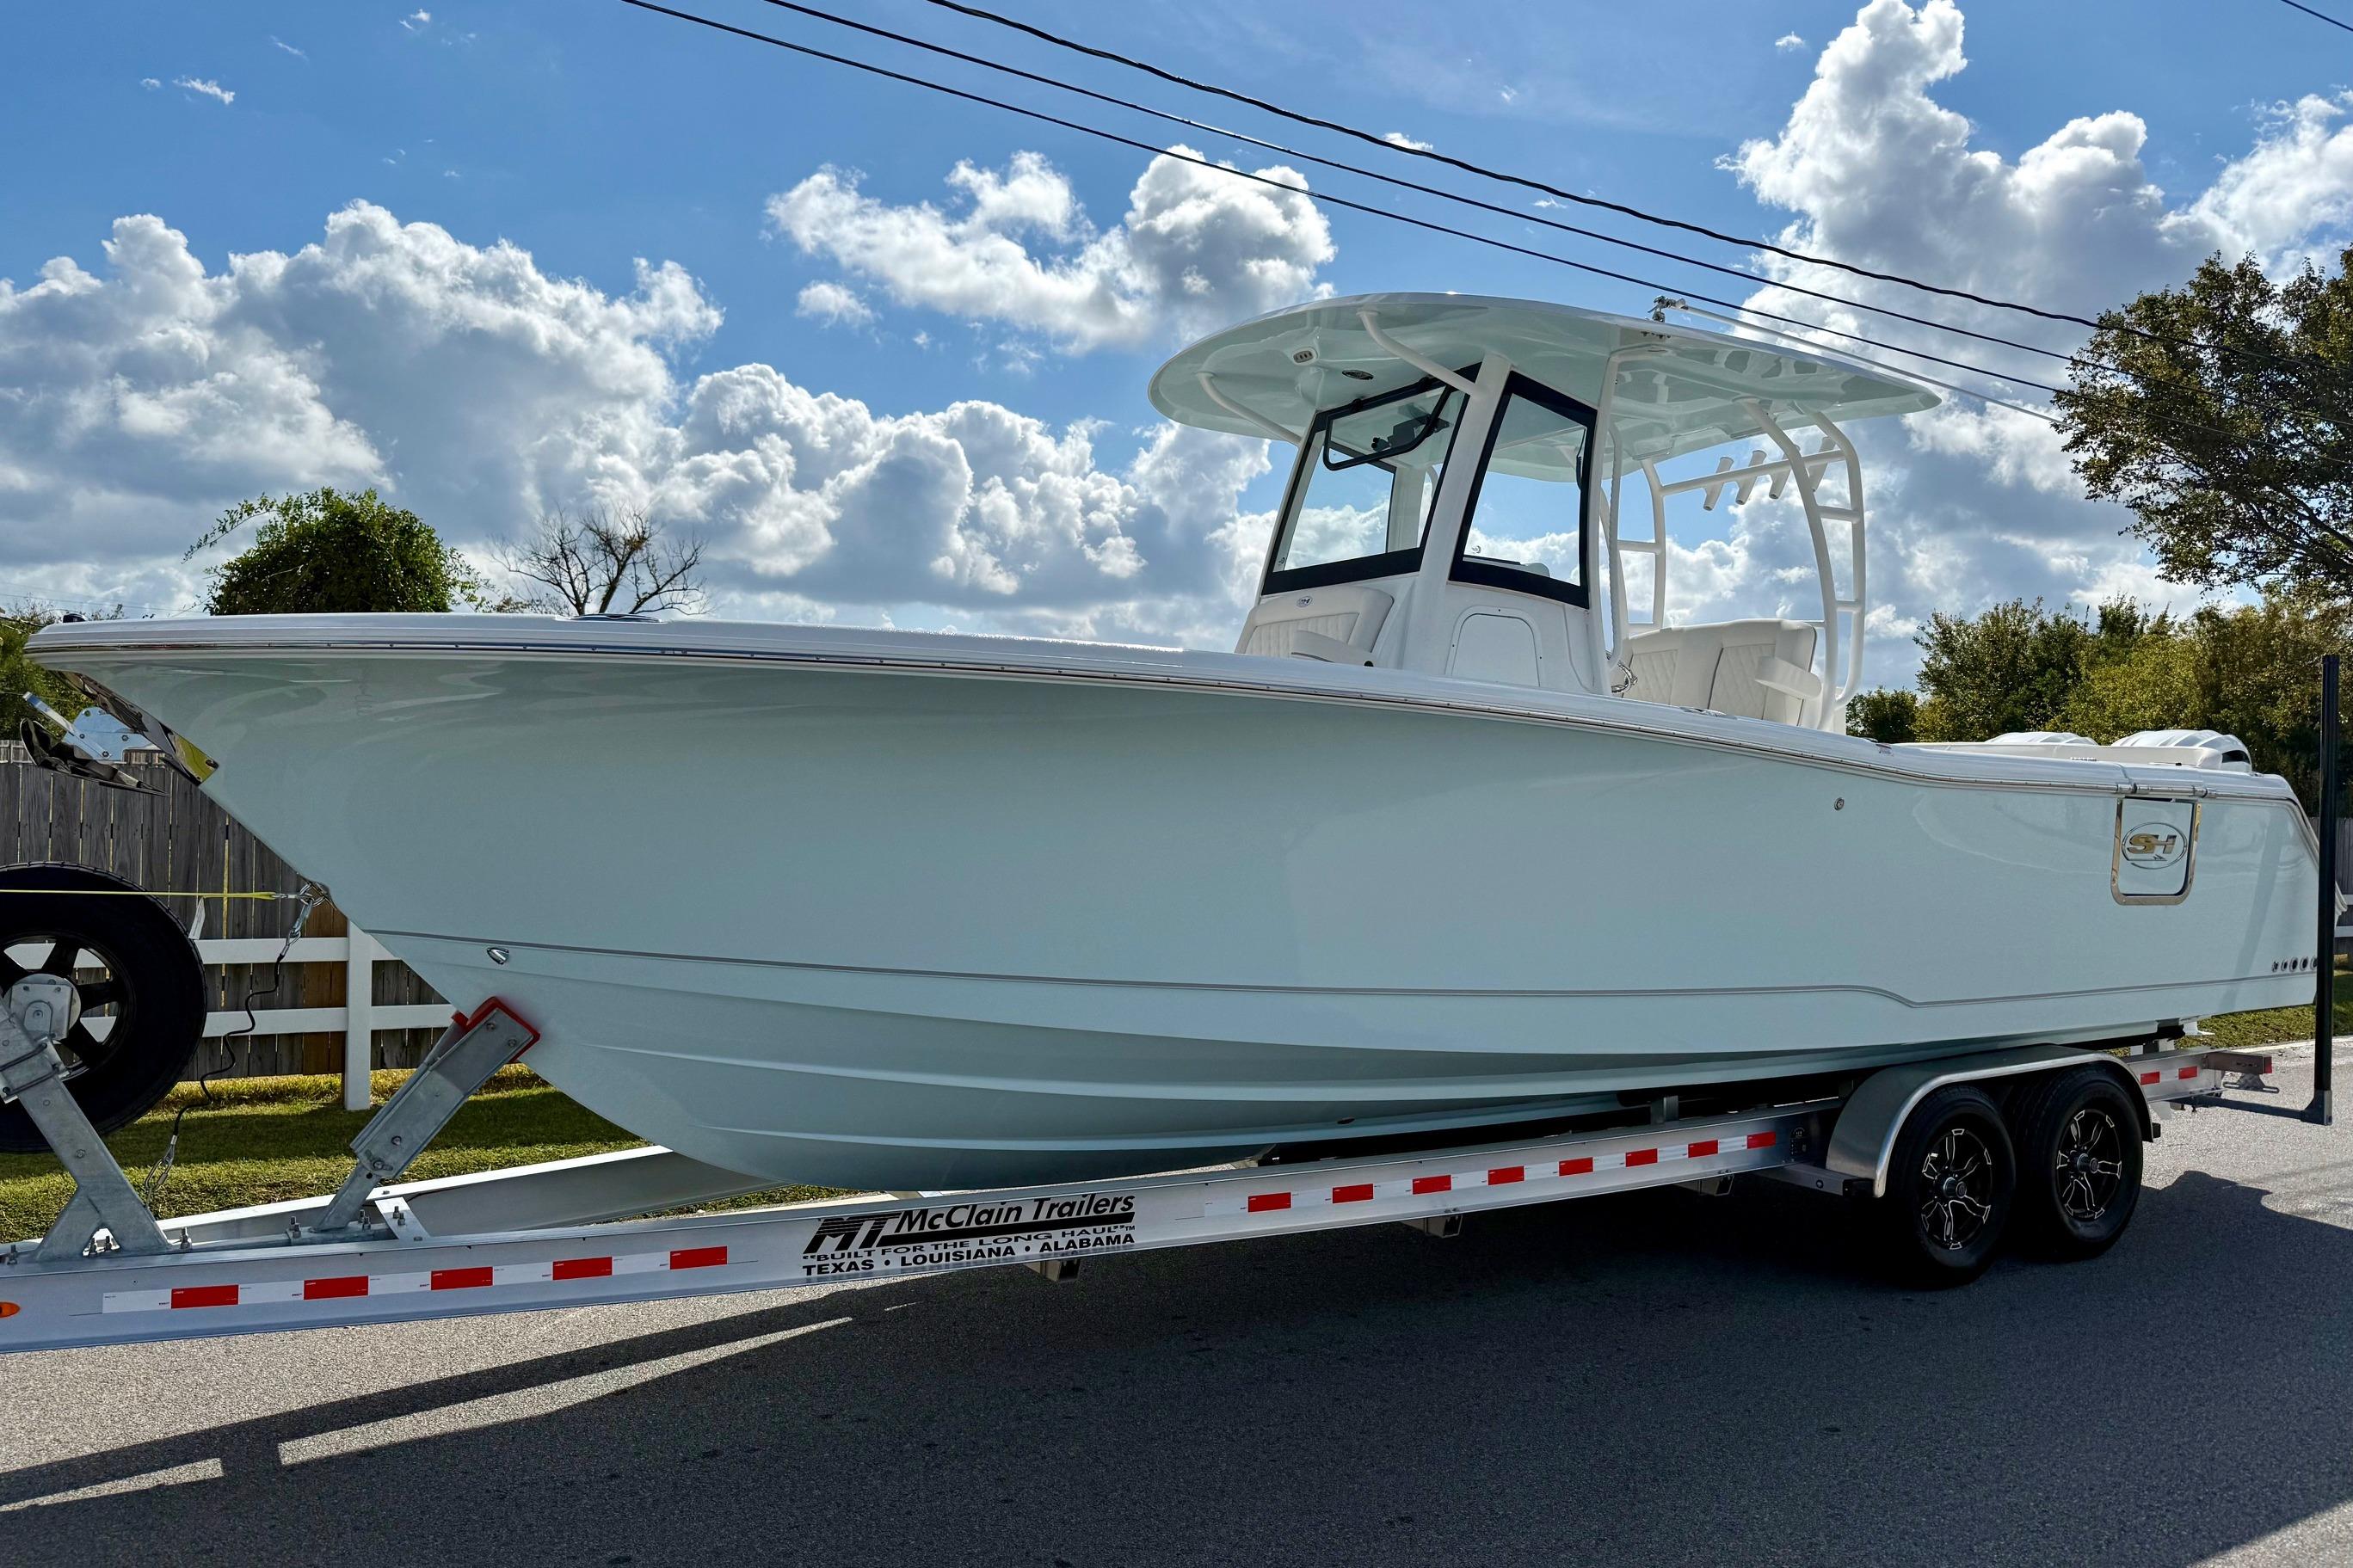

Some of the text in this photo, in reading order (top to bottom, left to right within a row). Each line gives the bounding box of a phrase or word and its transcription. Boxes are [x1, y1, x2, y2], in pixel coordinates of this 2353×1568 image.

[894, 1202, 1022, 1233] McClain
[1032, 1193, 1136, 1221] Trailers
[802, 1233, 1136, 1276] TEXAS LOUISIANA ALABAMA
[881, 1245, 925, 1255] FOR
[931, 1240, 970, 1251] THE
[978, 1233, 1052, 1246] LONG
